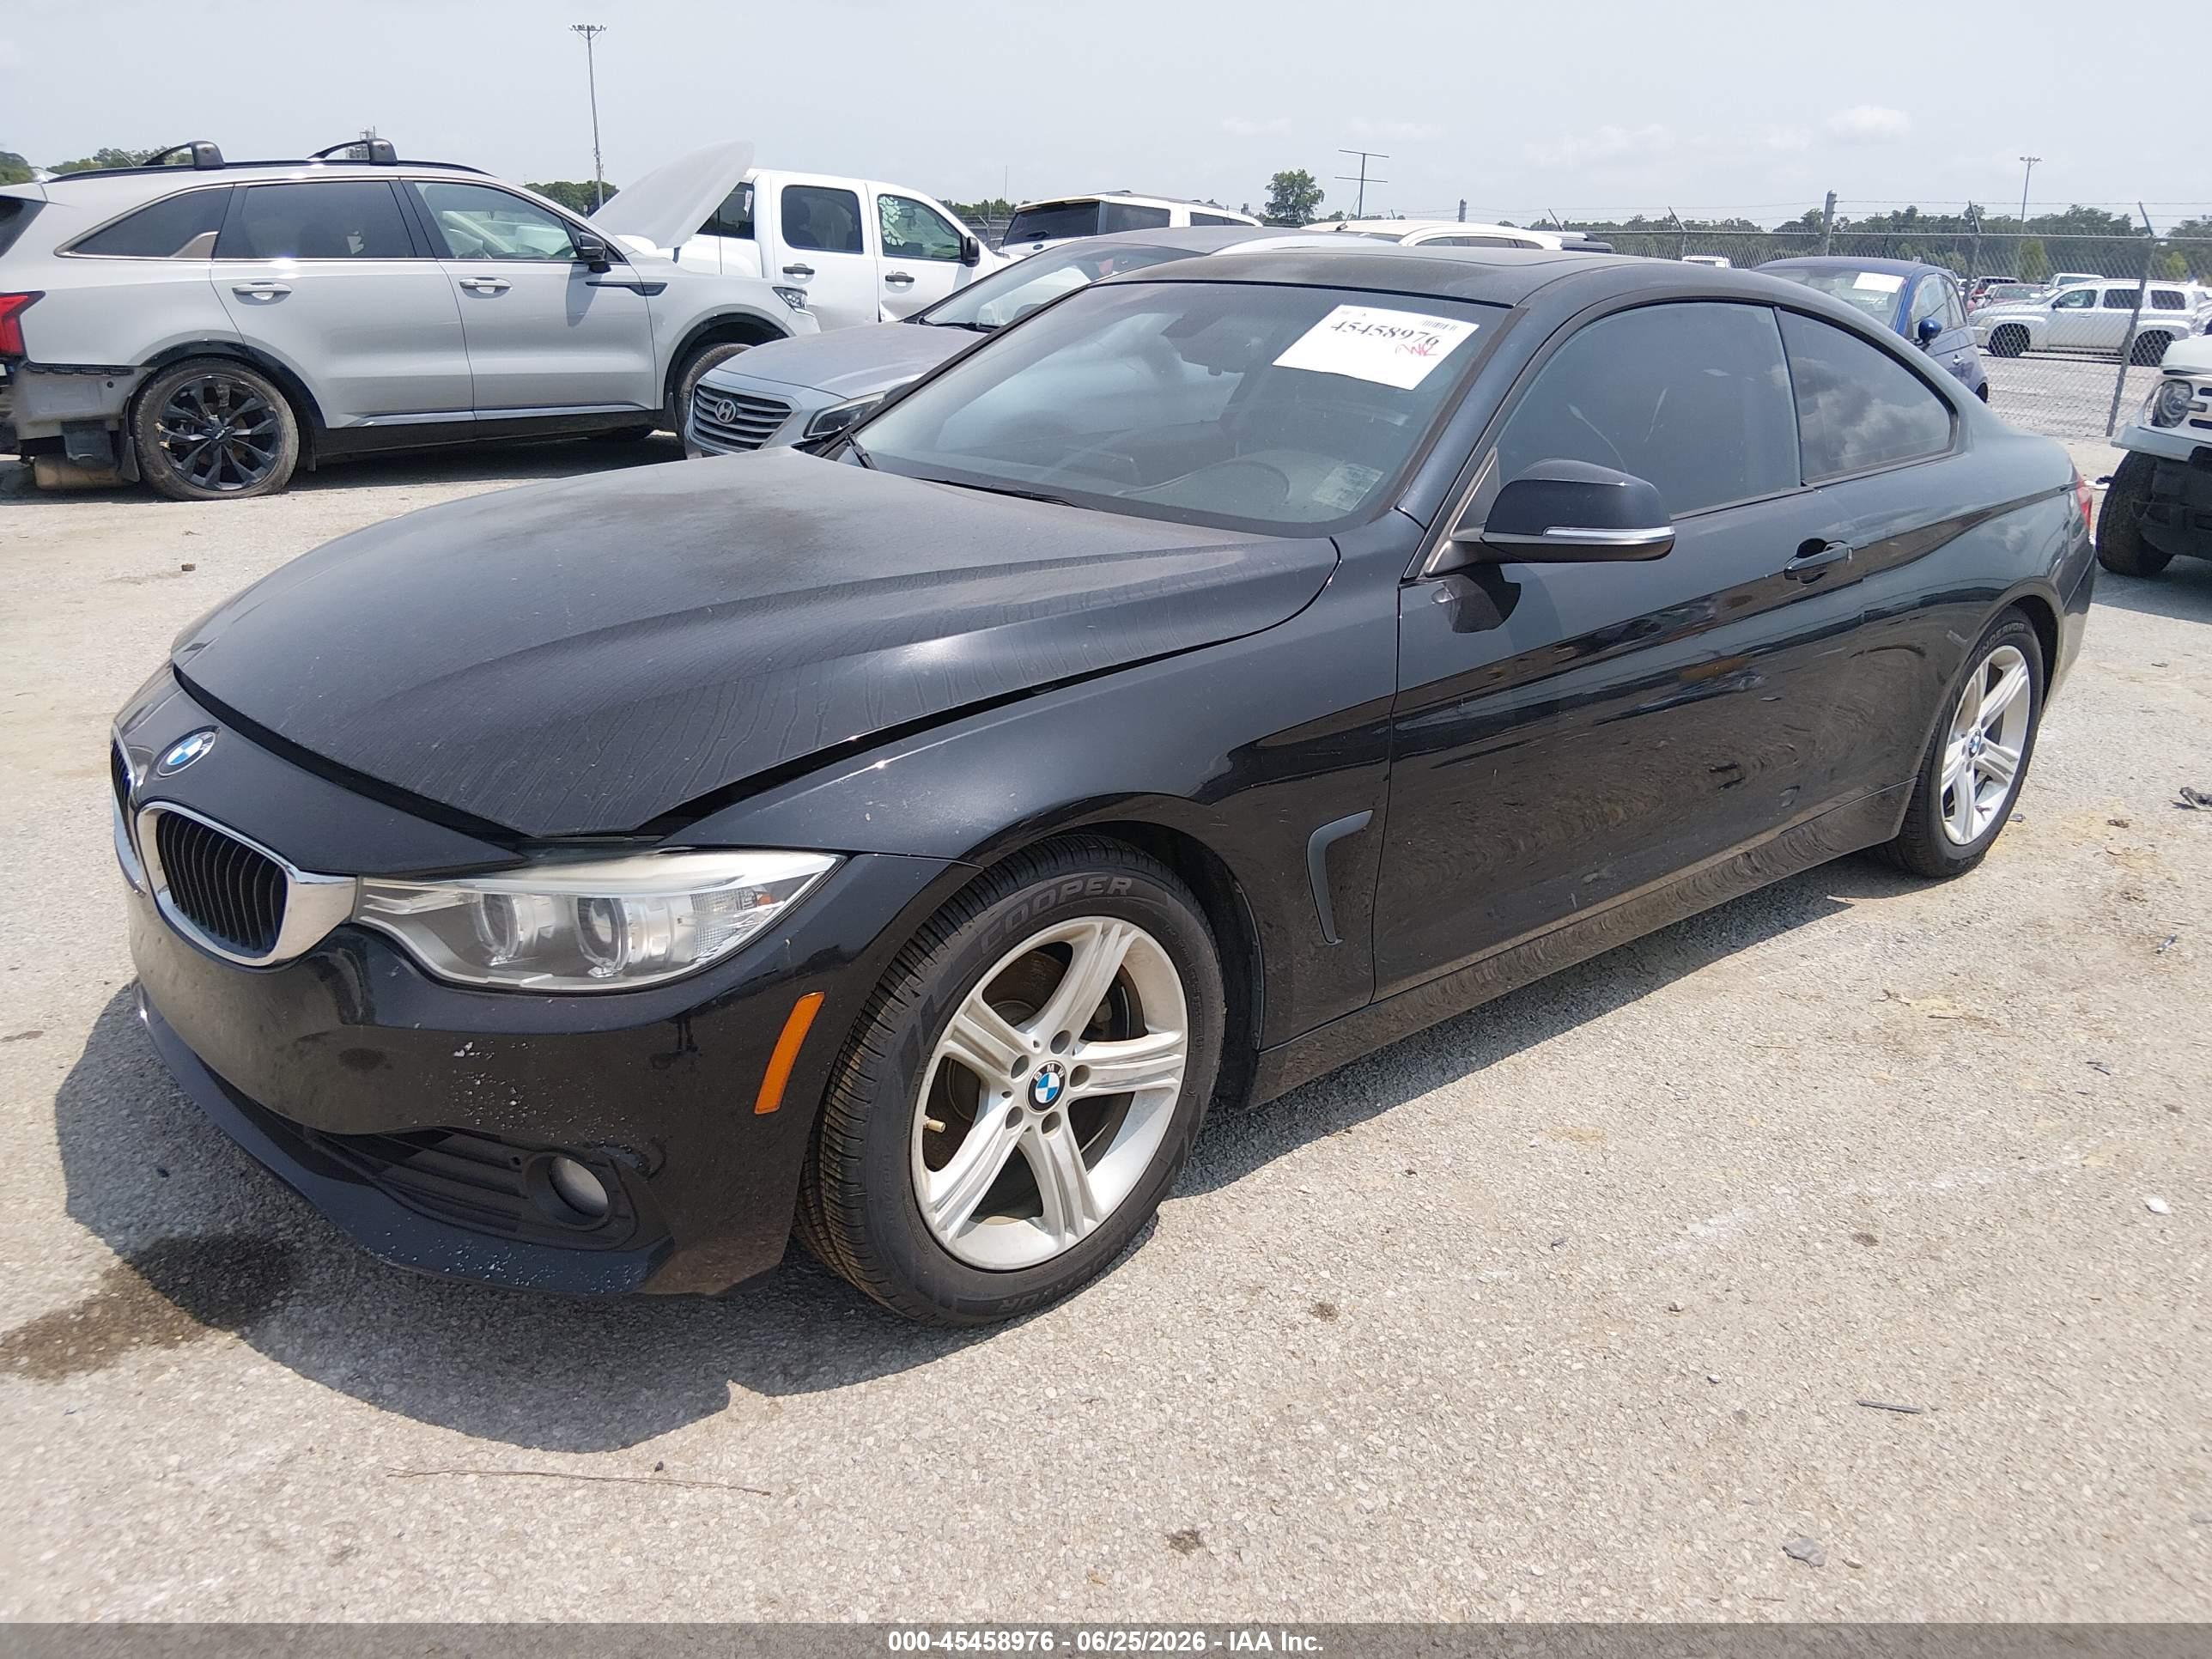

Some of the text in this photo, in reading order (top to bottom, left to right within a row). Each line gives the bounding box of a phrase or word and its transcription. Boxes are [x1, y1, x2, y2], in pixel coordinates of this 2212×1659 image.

[1330, 320, 1442, 346] 45458976
[981, 876, 1133, 955] COOPER
[1033, 1063, 1065, 1082] BMW
